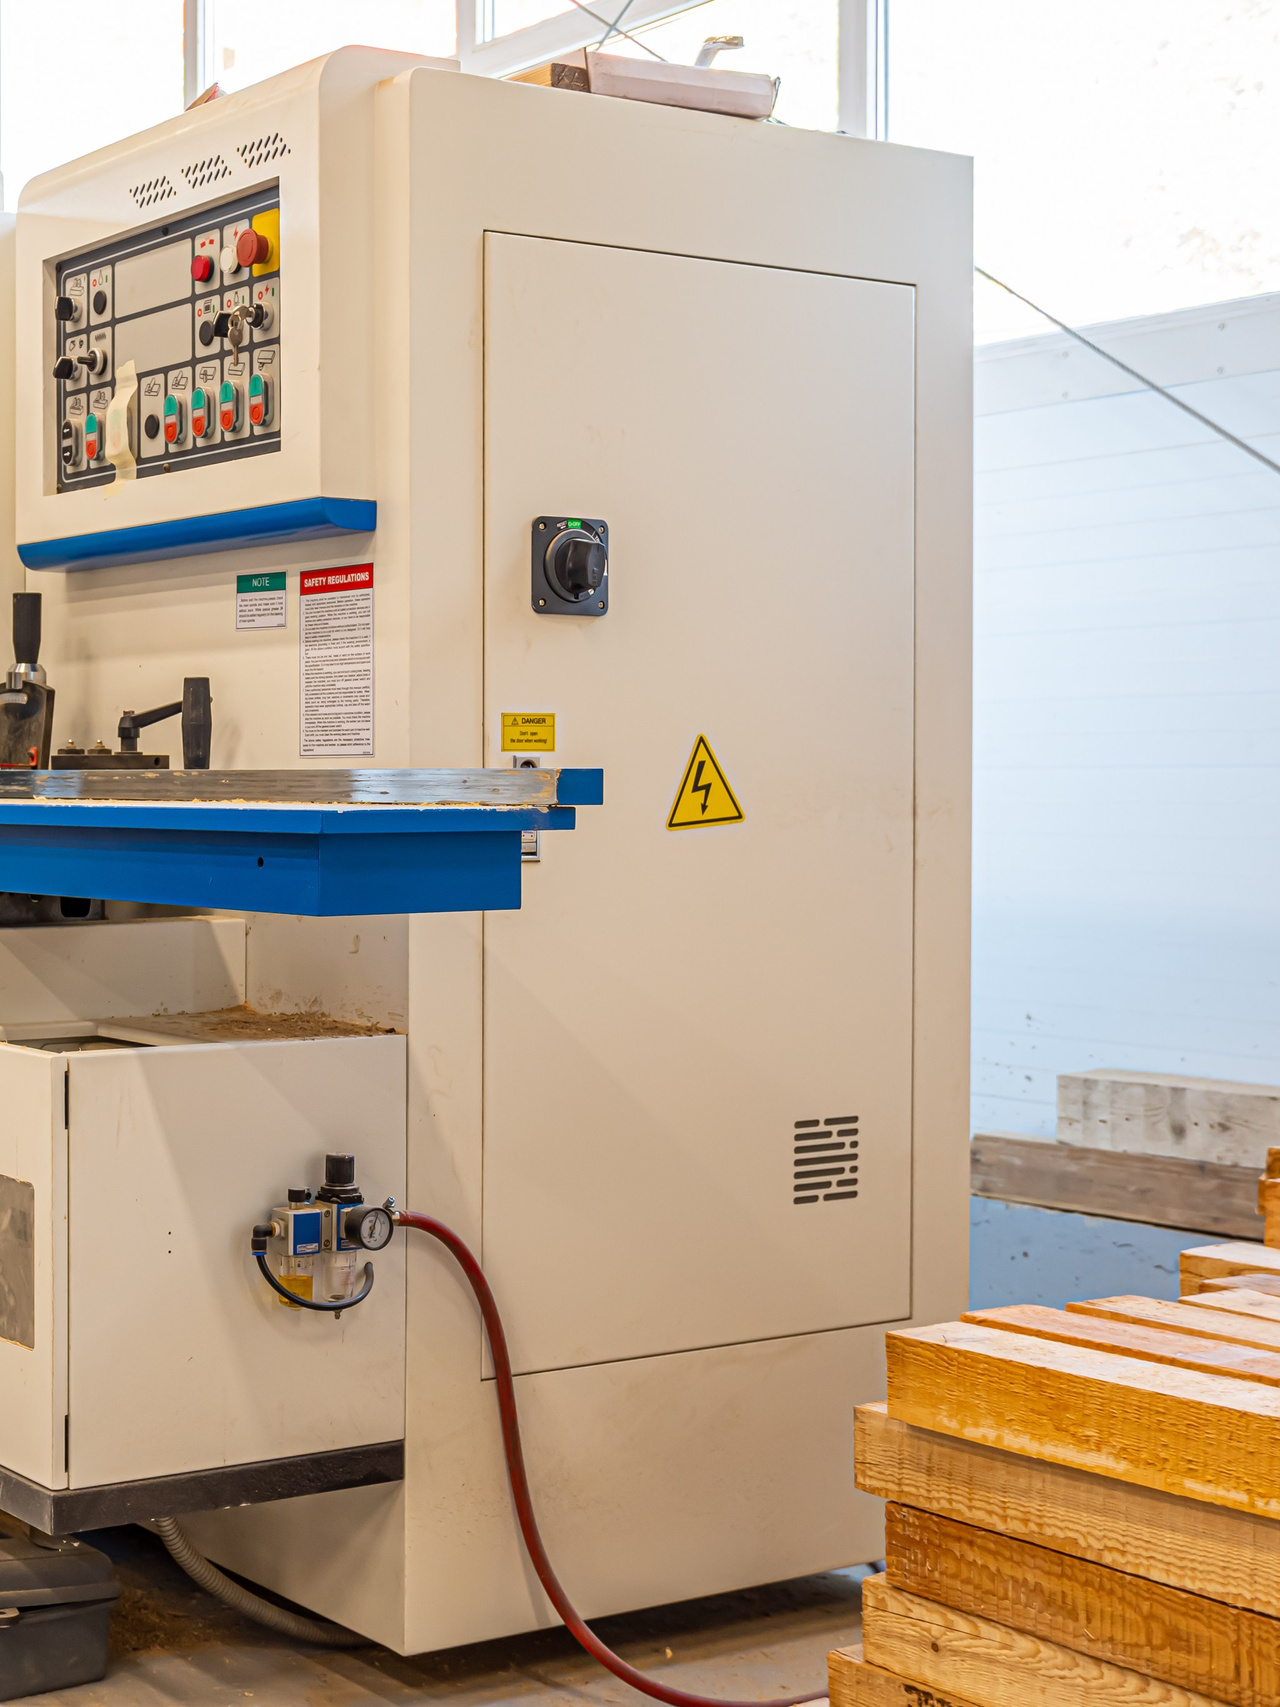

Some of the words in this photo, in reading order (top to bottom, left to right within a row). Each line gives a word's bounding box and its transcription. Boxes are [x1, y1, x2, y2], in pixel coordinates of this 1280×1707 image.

[252, 577, 270, 587] NOTE
[304, 577, 327, 588] SAFETY
[327, 571, 370, 585] REGULATIONS
